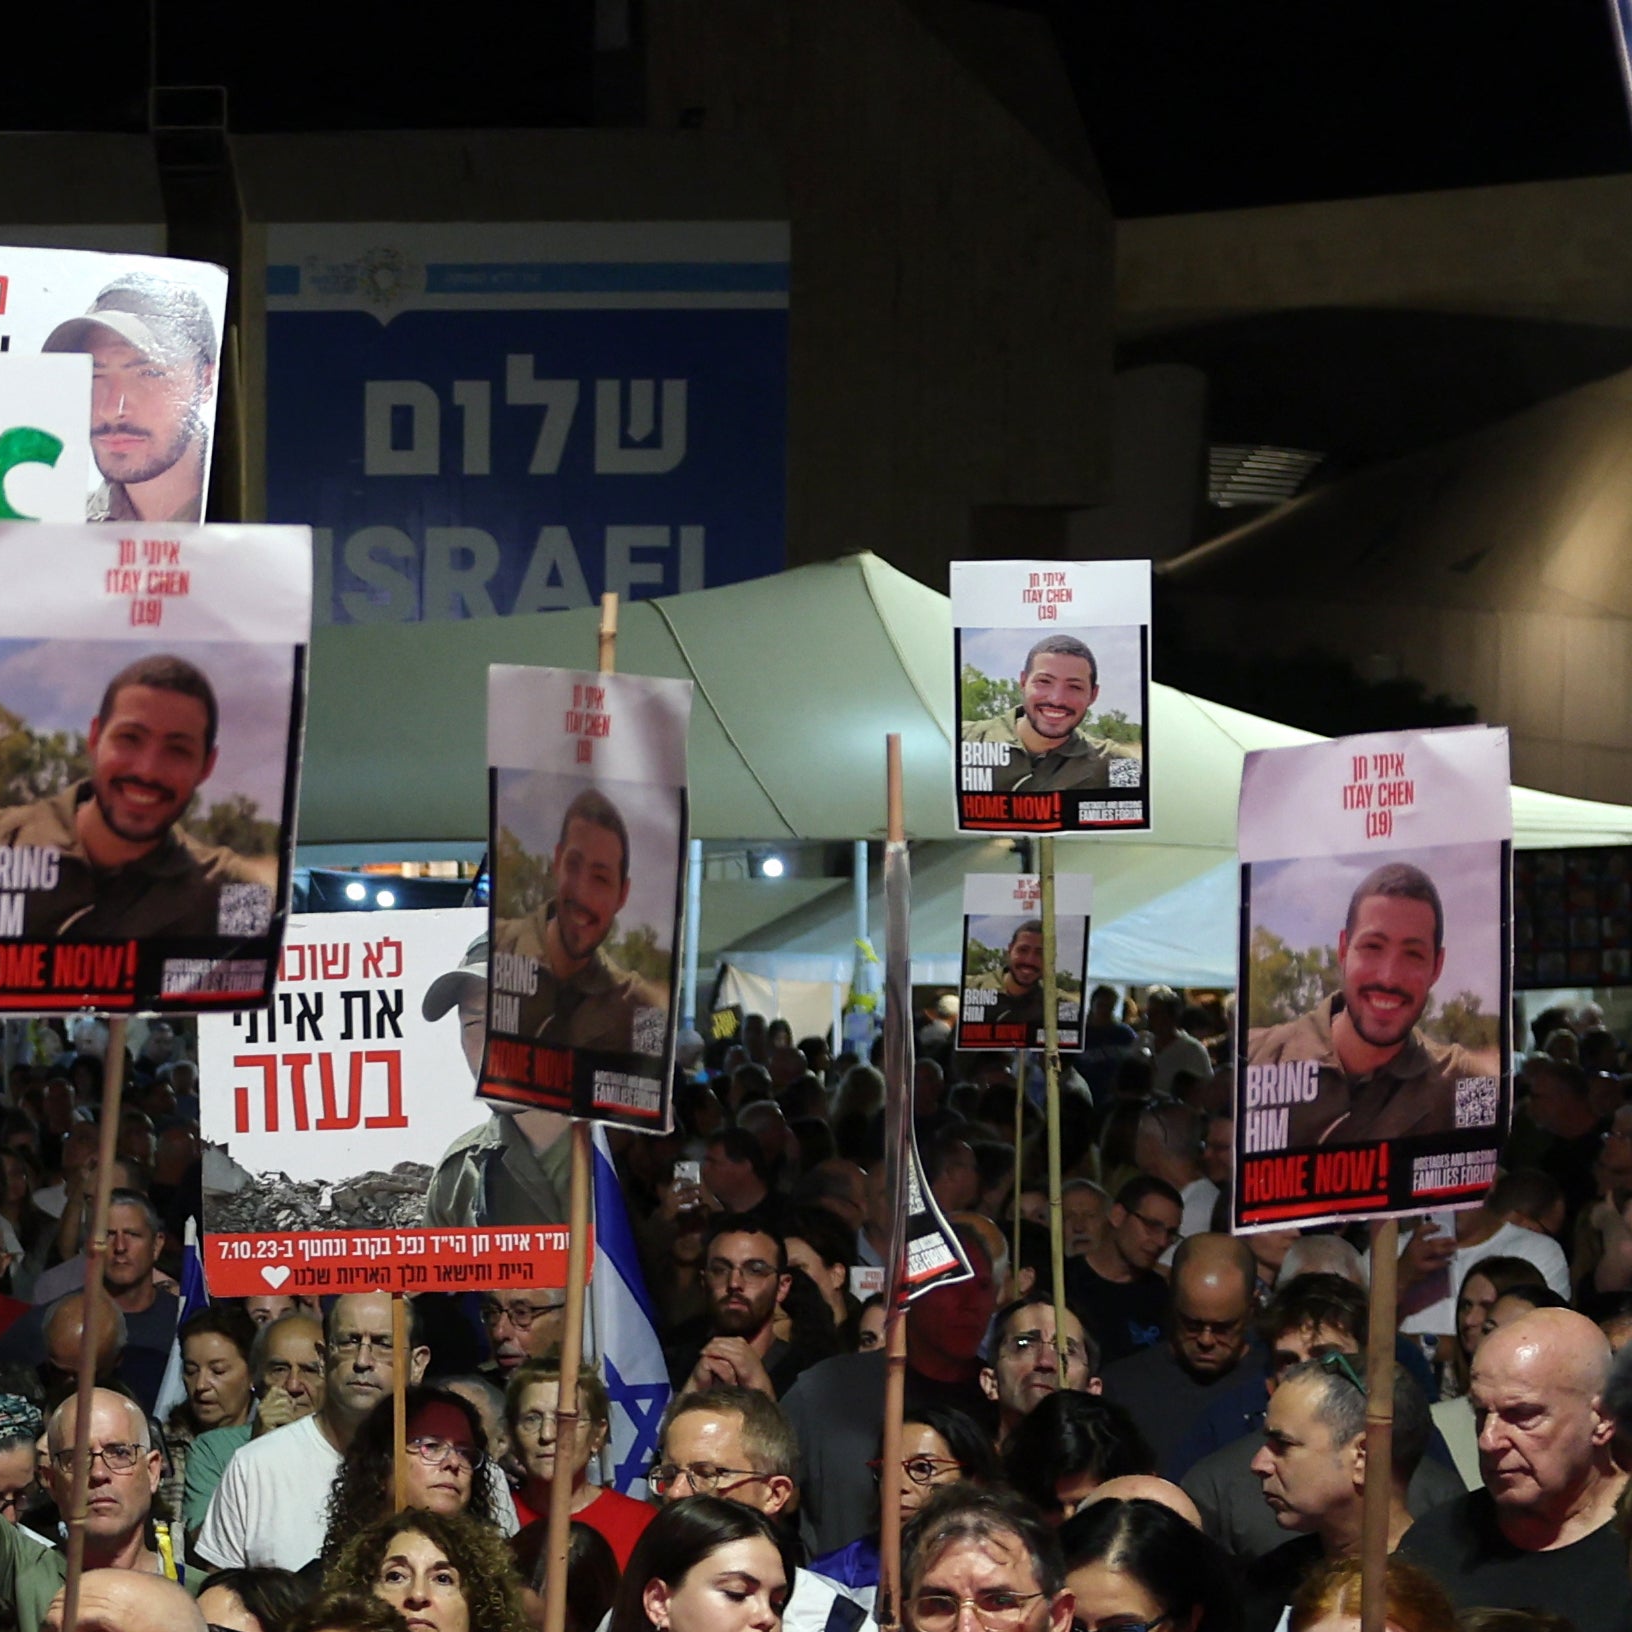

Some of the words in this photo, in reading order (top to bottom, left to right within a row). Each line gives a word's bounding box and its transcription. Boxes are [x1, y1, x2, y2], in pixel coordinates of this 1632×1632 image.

[364, 354, 688, 476] שלום
[118, 541, 137, 565] חן
[142, 540, 181, 565] איתי
[105, 571, 144, 594] ITAY
[148, 570, 190, 595] CHEN
[1028, 574, 1041, 588] חן
[1043, 572, 1066, 587] איתי
[1022, 589, 1045, 603] ITAY
[1047, 588, 1073, 603] CHEN
[130, 600, 162, 627] (19)
[1037, 604, 1058, 621] (19)
[961, 742, 1011, 766] BRING
[1372, 752, 1405, 777] איתי
[962, 767, 994, 791] HIM
[1352, 755, 1367, 782] חן
[962, 795, 1010, 819] HOME
[1013, 791, 1061, 820] NOW!
[1343, 782, 1374, 810] ITAY
[1377, 780, 1414, 808] CHEN
[1078, 808, 1113, 822] FAMILIES
[1115, 807, 1144, 821] FORUM
[1365, 809, 1393, 839] (19)
[53, 941, 137, 989] NOW!
[362, 936, 404, 978] לא
[963, 988, 998, 1005] BRING
[340, 989, 404, 1039] את
[234, 1050, 409, 1133] בעזה
[1245, 1060, 1318, 1107] BRING
[1245, 1109, 1290, 1154] HIM
[1244, 1156, 1309, 1202] HOME
[1314, 1142, 1389, 1194] NOW!
[1413, 1168, 1460, 1191] FAMILIES
[1462, 1164, 1496, 1185] FORUM
[298, 1239, 347, 1261] ונחטף
[352, 1237, 390, 1257] בקרב
[396, 1236, 425, 1254] נפל
[472, 1235, 489, 1258] חן
[495, 1233, 531, 1252] איתי
[294, 1268, 331, 1286] שלנו
[336, 1266, 391, 1286] האריות
[398, 1265, 427, 1287] מלך
[498, 1262, 534, 1281] היית
